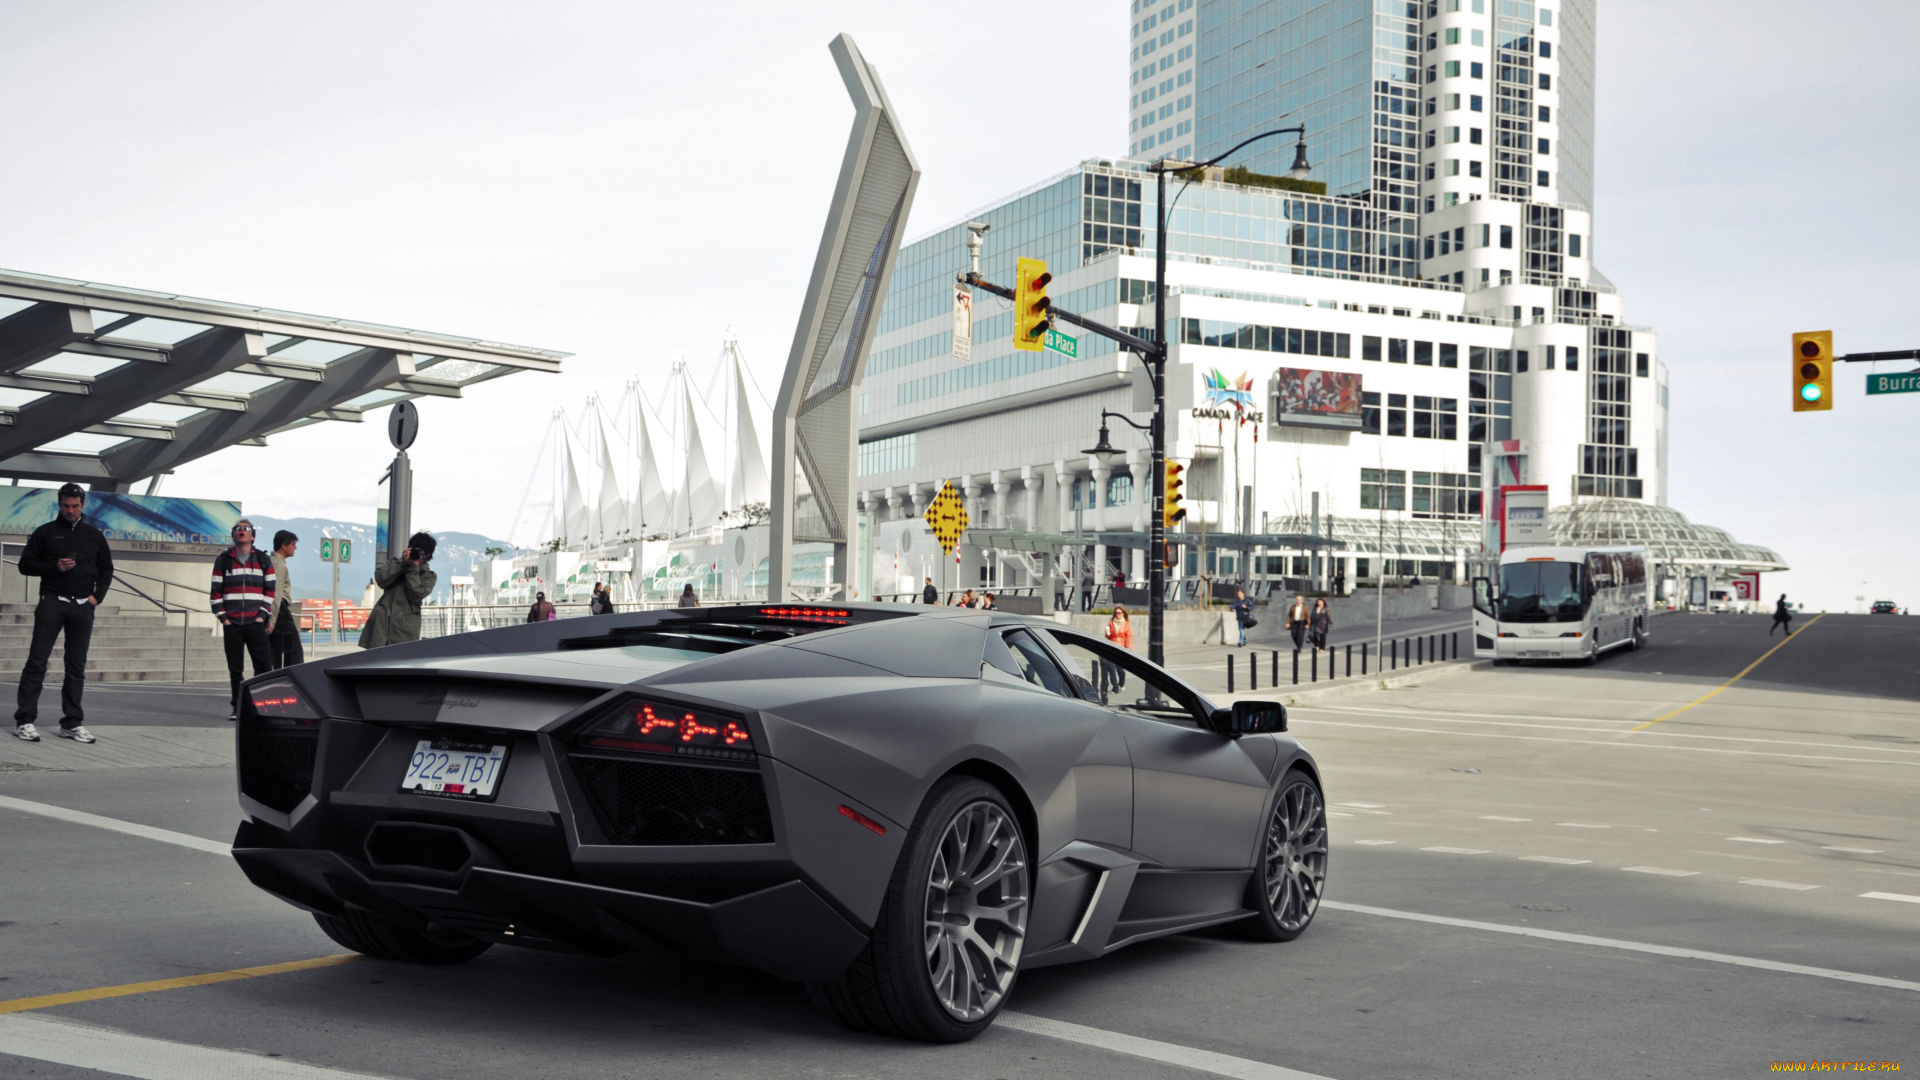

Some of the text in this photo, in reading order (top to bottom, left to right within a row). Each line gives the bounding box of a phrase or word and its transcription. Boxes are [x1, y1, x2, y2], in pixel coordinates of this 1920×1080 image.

[1056, 334, 1075, 355] Place
[1192, 408, 1231, 420] CANADA
[97, 528, 235, 545] ONVENTION CENTR
[131, 542, 154, 551] WEST
[408, 751, 501, 784] 922 TBT
